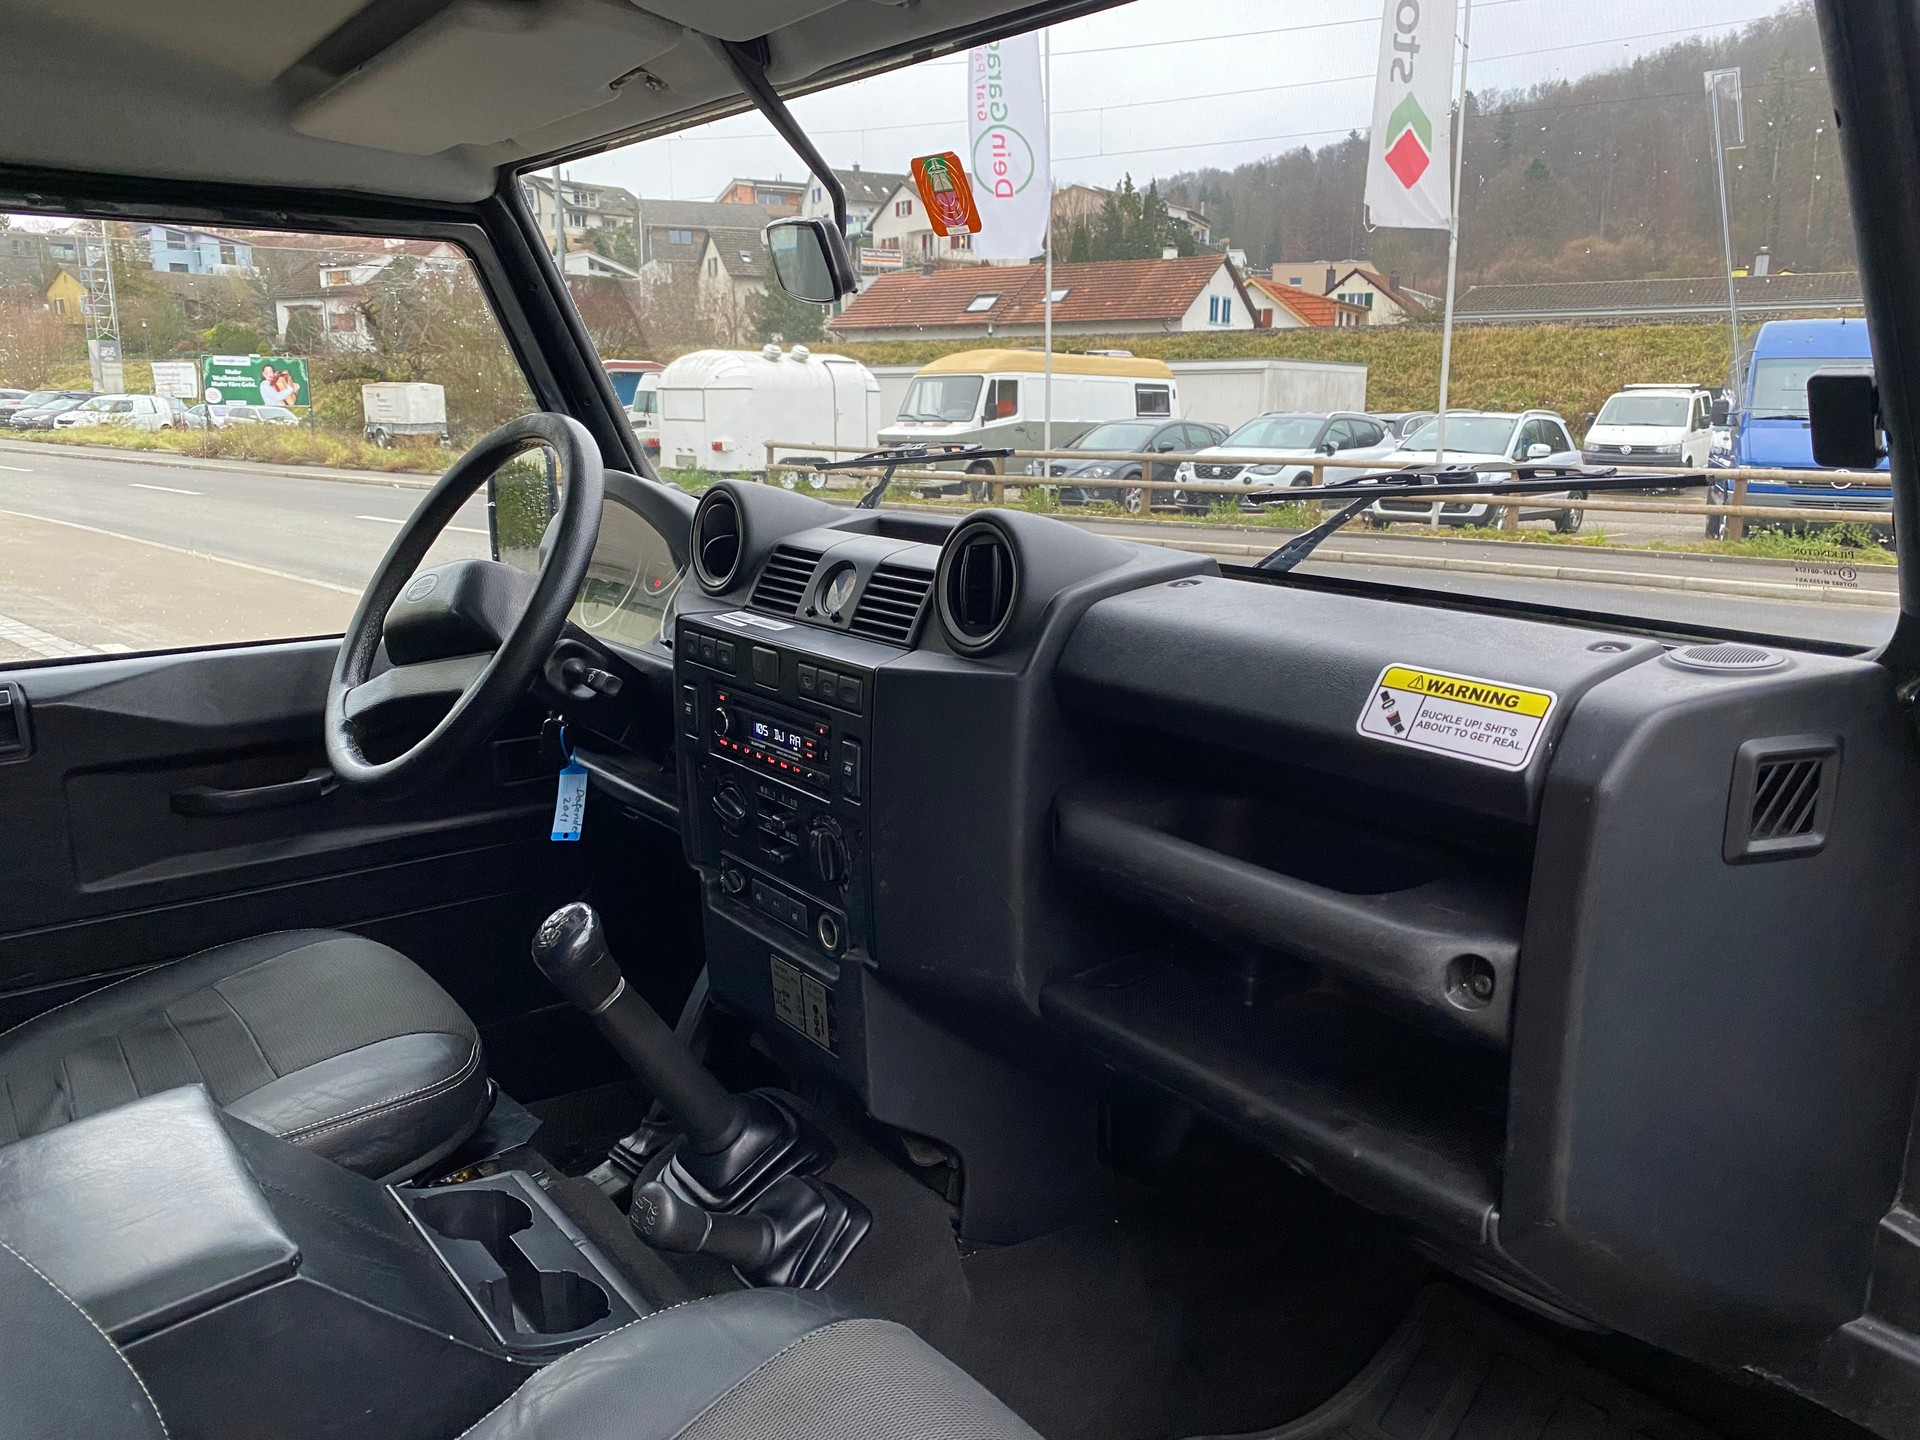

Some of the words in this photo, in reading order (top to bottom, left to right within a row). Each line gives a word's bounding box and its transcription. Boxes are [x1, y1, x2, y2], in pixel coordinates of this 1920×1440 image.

[1427, 679, 1520, 708] WARNING
[1415, 720, 1453, 736] ABOUT
[1453, 728, 1468, 738] TO
[1469, 731, 1491, 744] GET
[1492, 737, 1524, 751] REAL.
[1420, 709, 1462, 726] BUCKLE
[1464, 717, 1482, 730] UP!
[1483, 722, 1518, 737] SHIT'S
